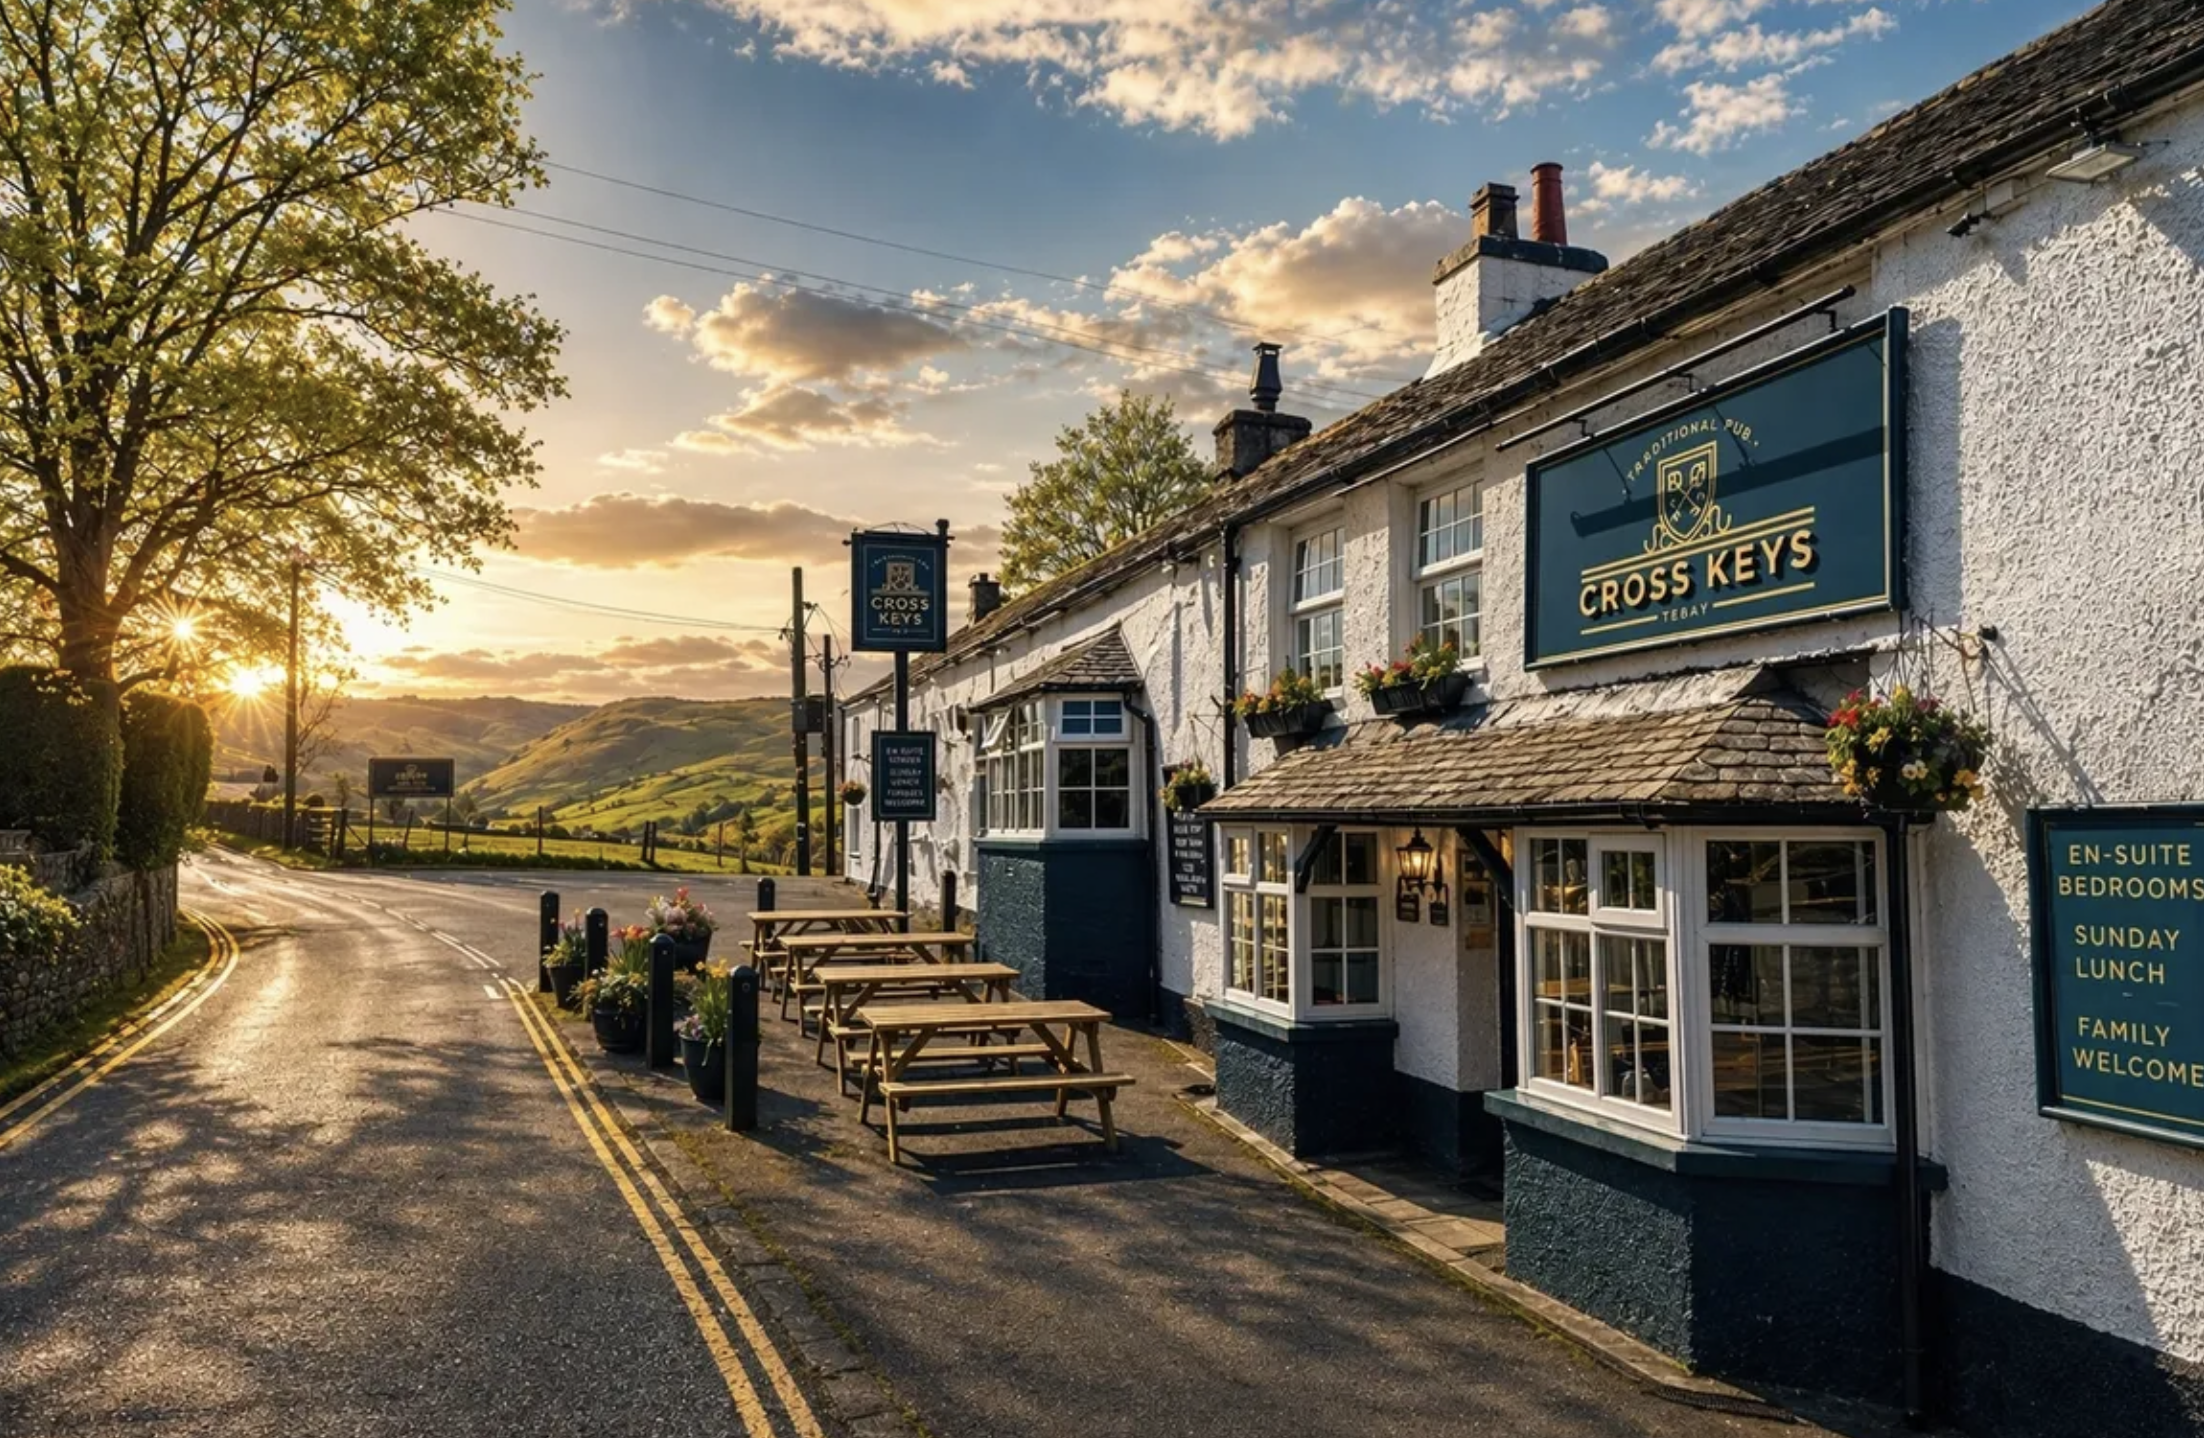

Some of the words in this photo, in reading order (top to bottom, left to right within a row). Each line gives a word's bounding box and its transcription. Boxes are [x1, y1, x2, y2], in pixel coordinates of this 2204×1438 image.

[1579, 561, 1691, 616] CROSS
[1708, 530, 1814, 588] KEYS
[870, 597, 930, 611] CROSS
[1661, 603, 1709, 623] TEBAY
[879, 612, 923, 625] KEYS
[2068, 844, 2192, 865] EN-SUITE
[2058, 875, 2204, 900] BEDROOMS
[2074, 924, 2180, 951] SUNDAY
[2075, 956, 2166, 985] LUNCH
[2077, 1016, 2171, 1047] FAMILY
[2072, 1046, 2204, 1088] WELCOME
